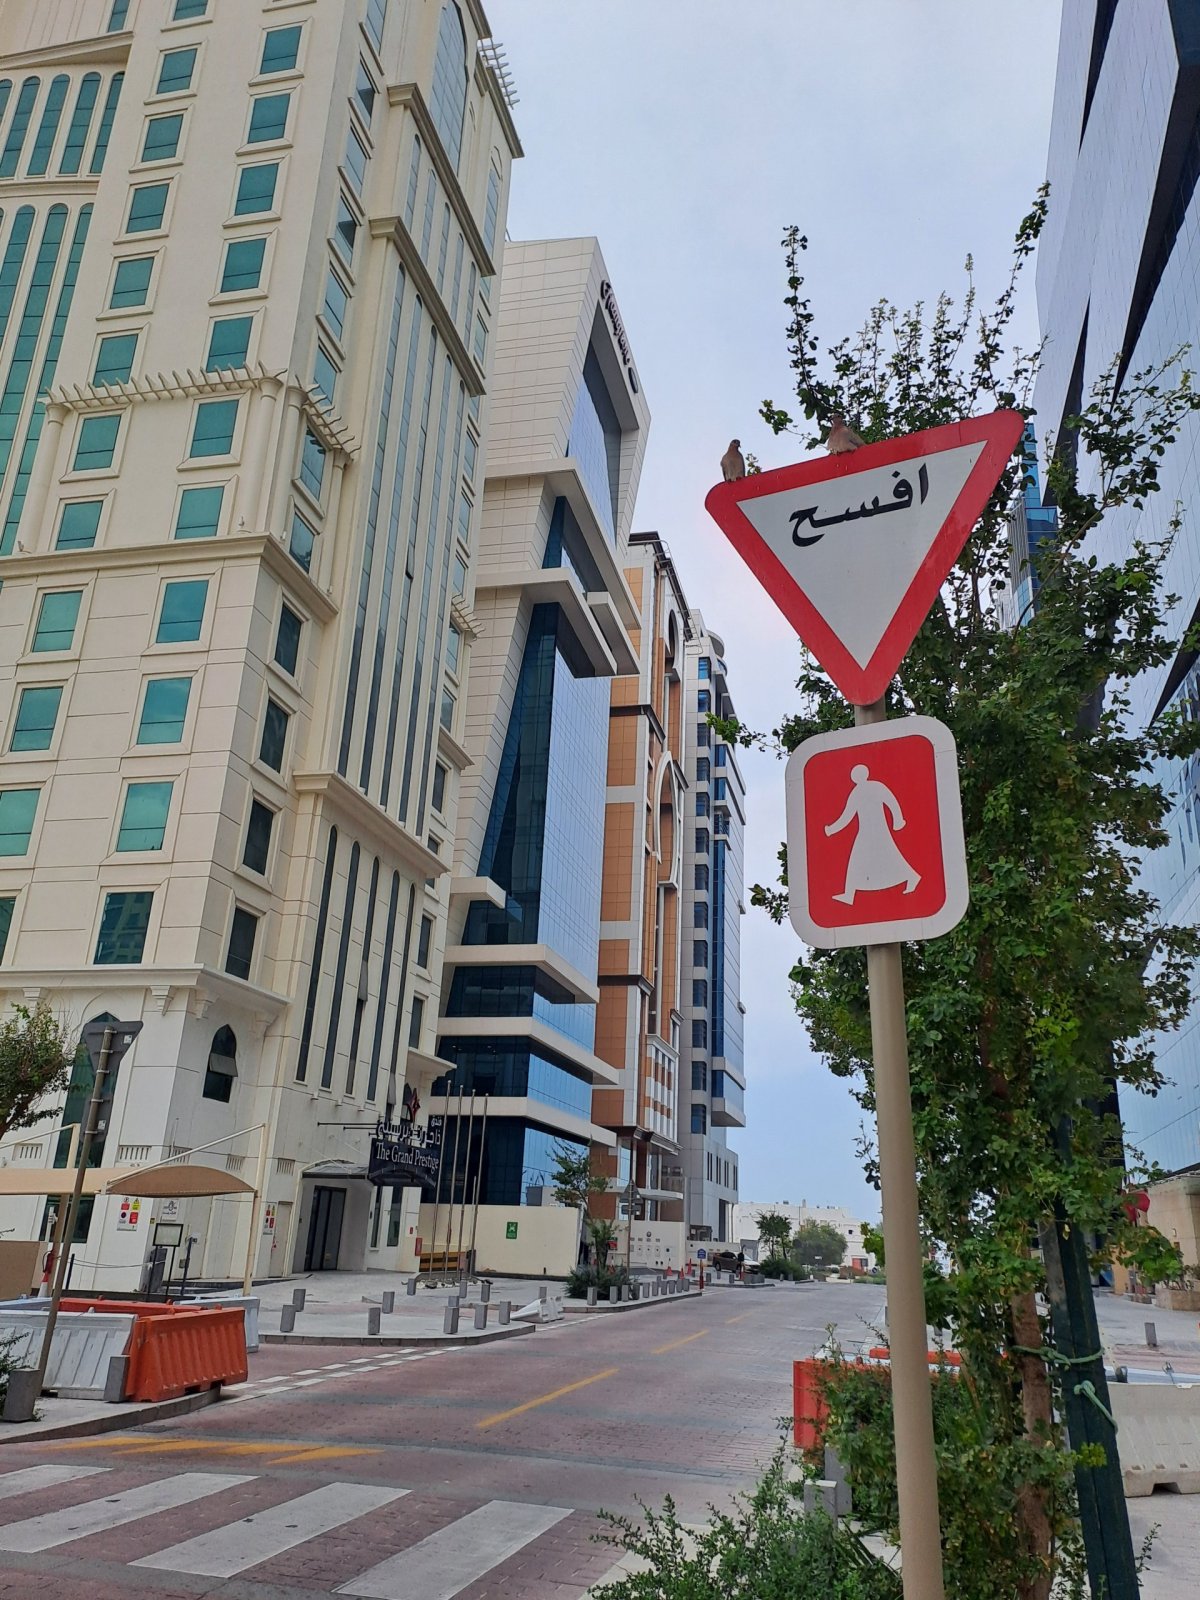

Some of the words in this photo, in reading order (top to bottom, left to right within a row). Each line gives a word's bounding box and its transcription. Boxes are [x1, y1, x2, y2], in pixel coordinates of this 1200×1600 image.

[788, 462, 929, 548] افسح
[430, 1114, 443, 1127] فندق
[376, 1142, 390, 1161] The
[391, 1145, 414, 1165] Grand
[414, 1150, 439, 1174] Prestige
